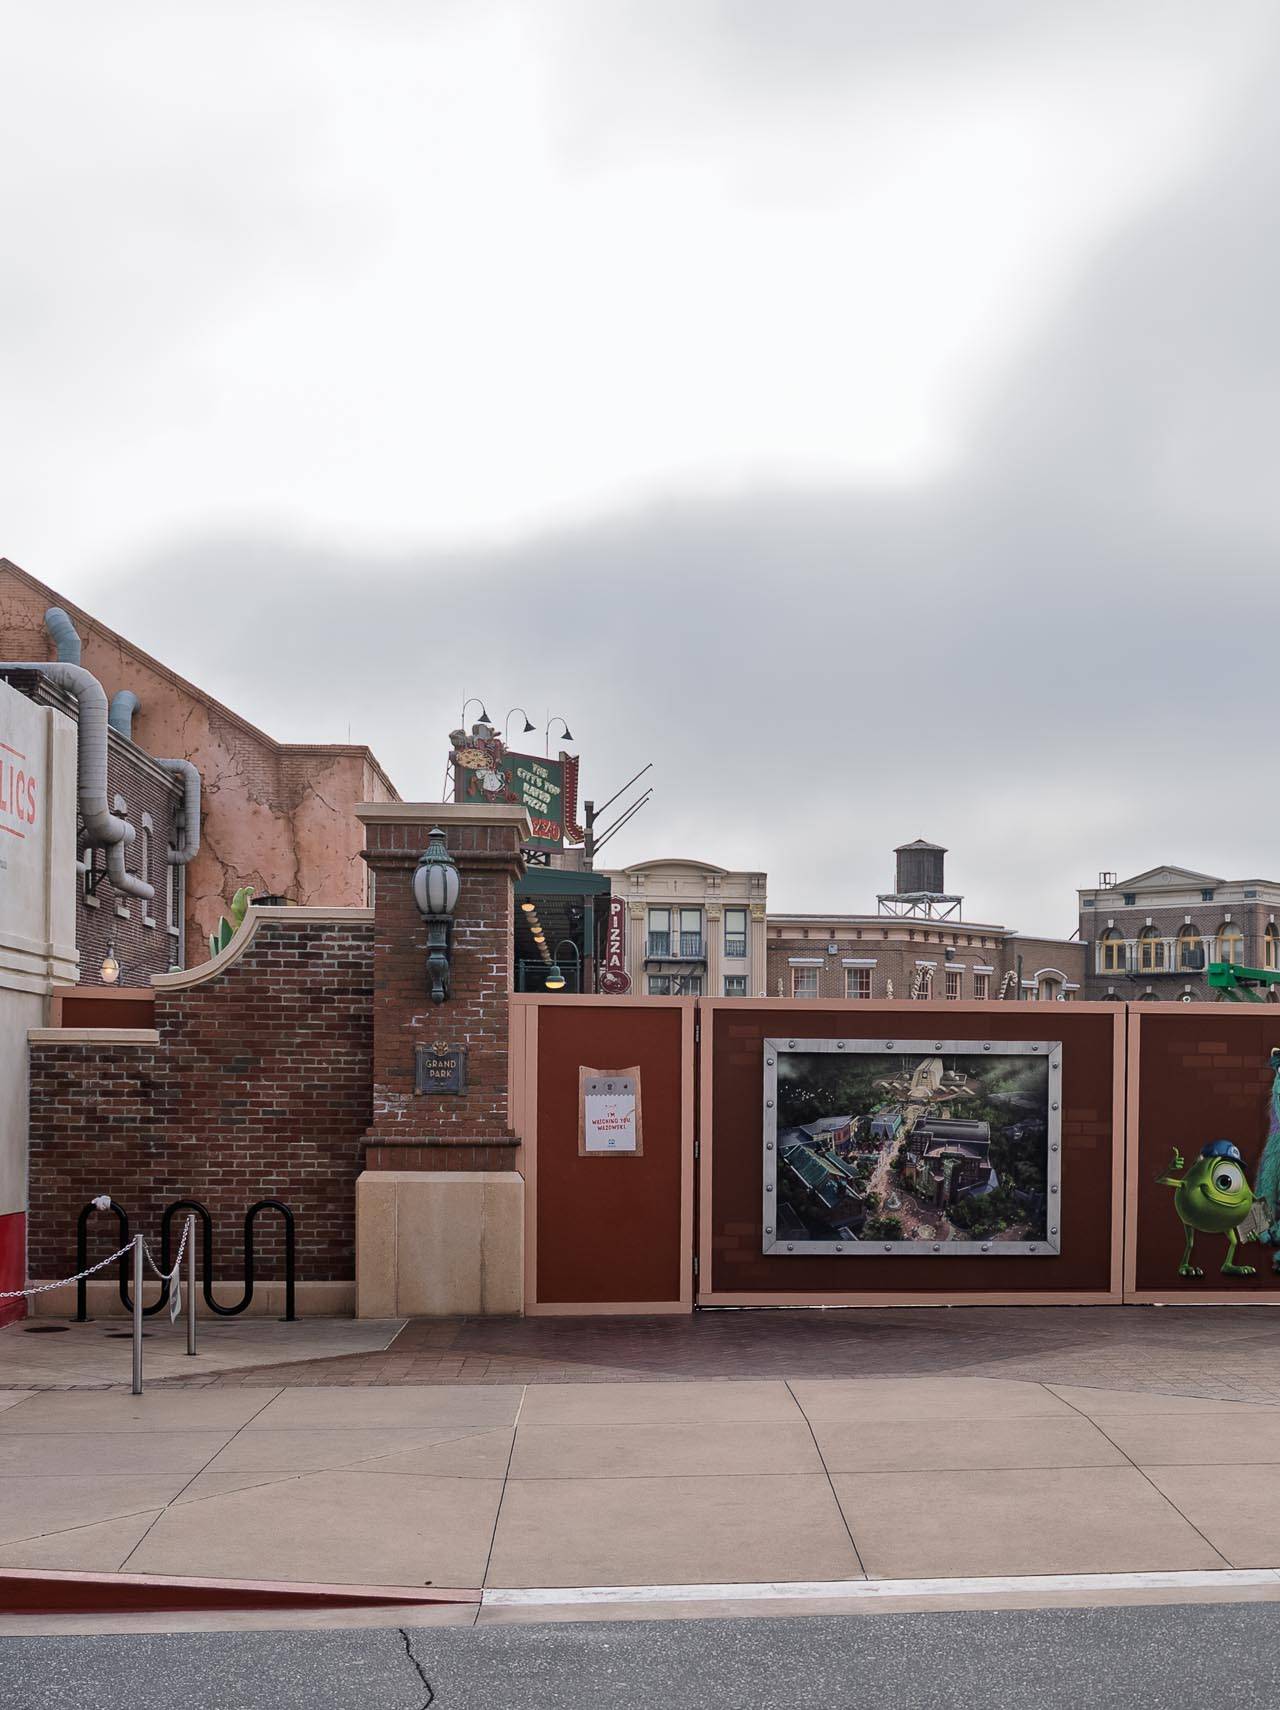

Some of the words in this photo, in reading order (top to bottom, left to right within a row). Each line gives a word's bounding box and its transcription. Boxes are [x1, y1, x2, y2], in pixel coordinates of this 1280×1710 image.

[522, 793, 548, 815] PIZZA
[610, 903, 621, 967] PIZZA
[425, 1060, 457, 1069] GRAND
[430, 1070, 452, 1078] PARK
